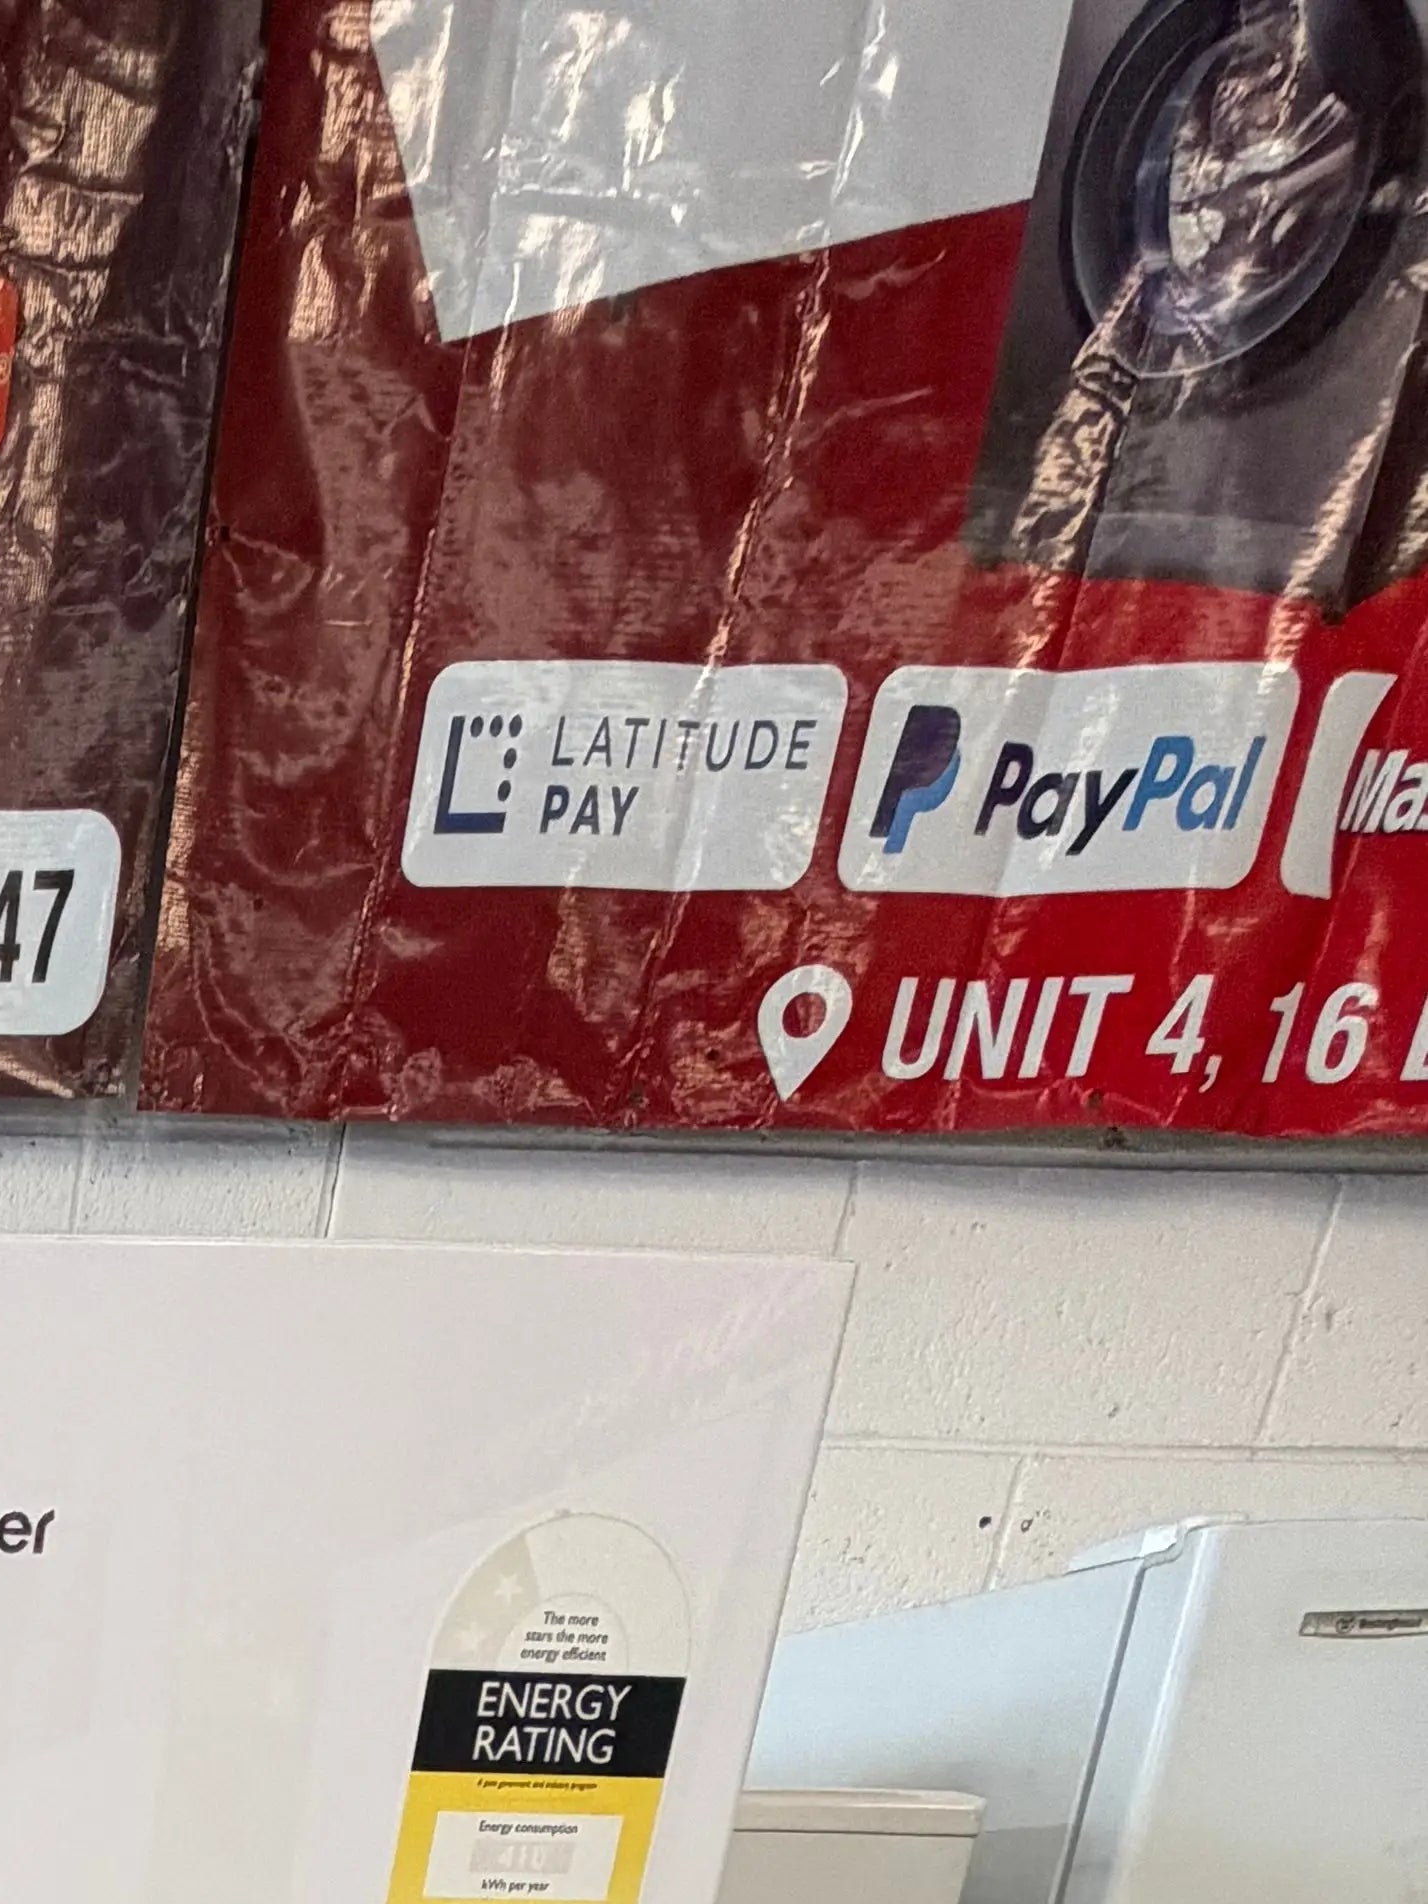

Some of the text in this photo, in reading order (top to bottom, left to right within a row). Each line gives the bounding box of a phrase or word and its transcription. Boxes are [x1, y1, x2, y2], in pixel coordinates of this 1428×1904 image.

[549, 718, 819, 774] LATITUDE
[538, 787, 642, 837] PAY
[973, 736, 1267, 857] PayPal
[880, 973, 1135, 1082] UNIT
[1143, 973, 1224, 1093] 4,
[1265, 981, 1379, 1085] 16
[525, 1629, 609, 1645] stars the more
[543, 1610, 600, 1627] The more
[520, 1646, 608, 1663] energy efficient
[476, 1680, 633, 1721] ENERGY
[471, 1725, 617, 1765] RATING
[478, 1819, 579, 1837] Energy consumption
[508, 1881, 526, 1893] per
[527, 1882, 551, 1894] year
